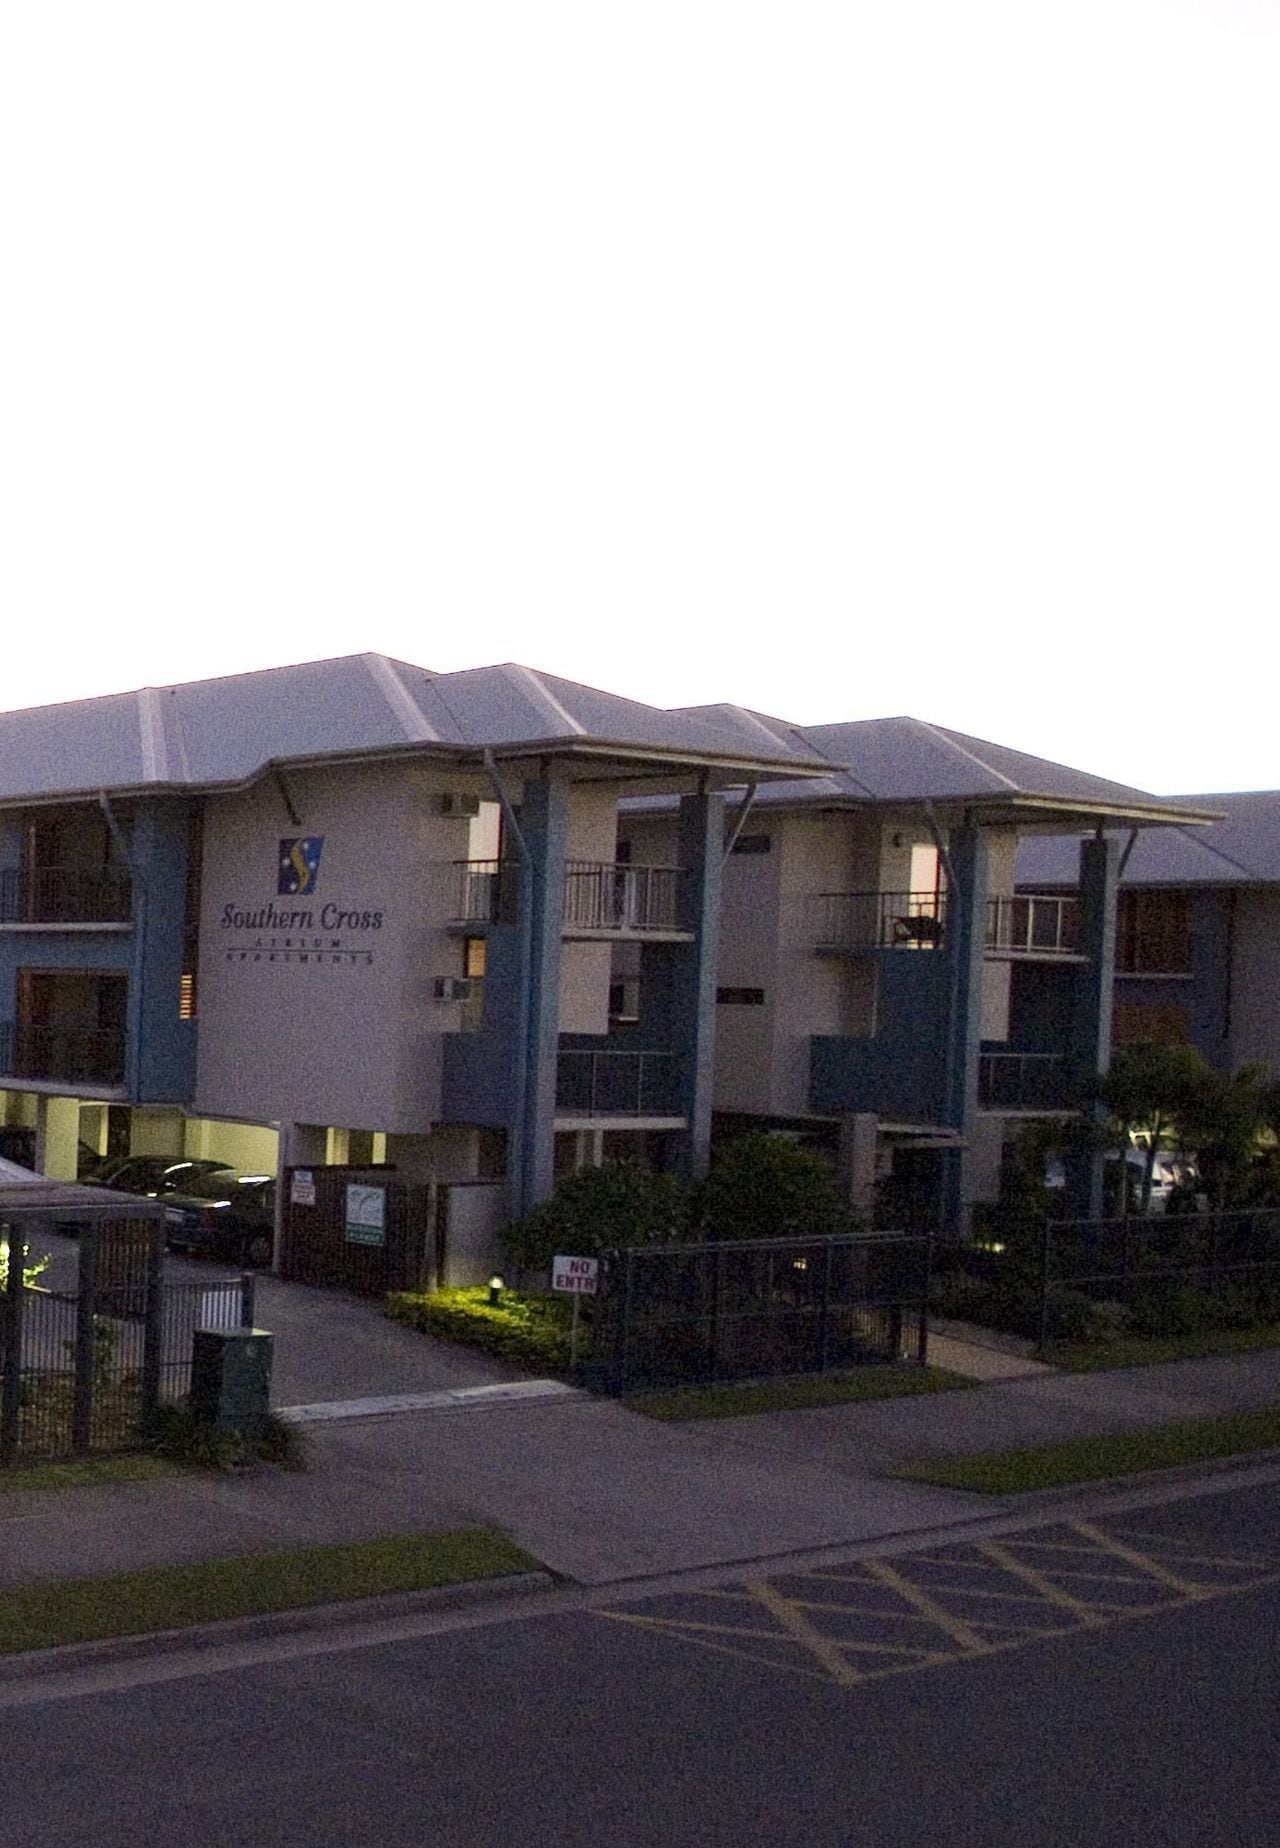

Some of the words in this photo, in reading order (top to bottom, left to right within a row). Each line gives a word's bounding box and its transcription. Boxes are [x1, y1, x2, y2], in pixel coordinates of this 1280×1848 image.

[221, 902, 314, 930] Southern
[320, 902, 383, 930] Cross
[570, 1260, 590, 1274] NO
[556, 1274, 594, 1290] ENTR
